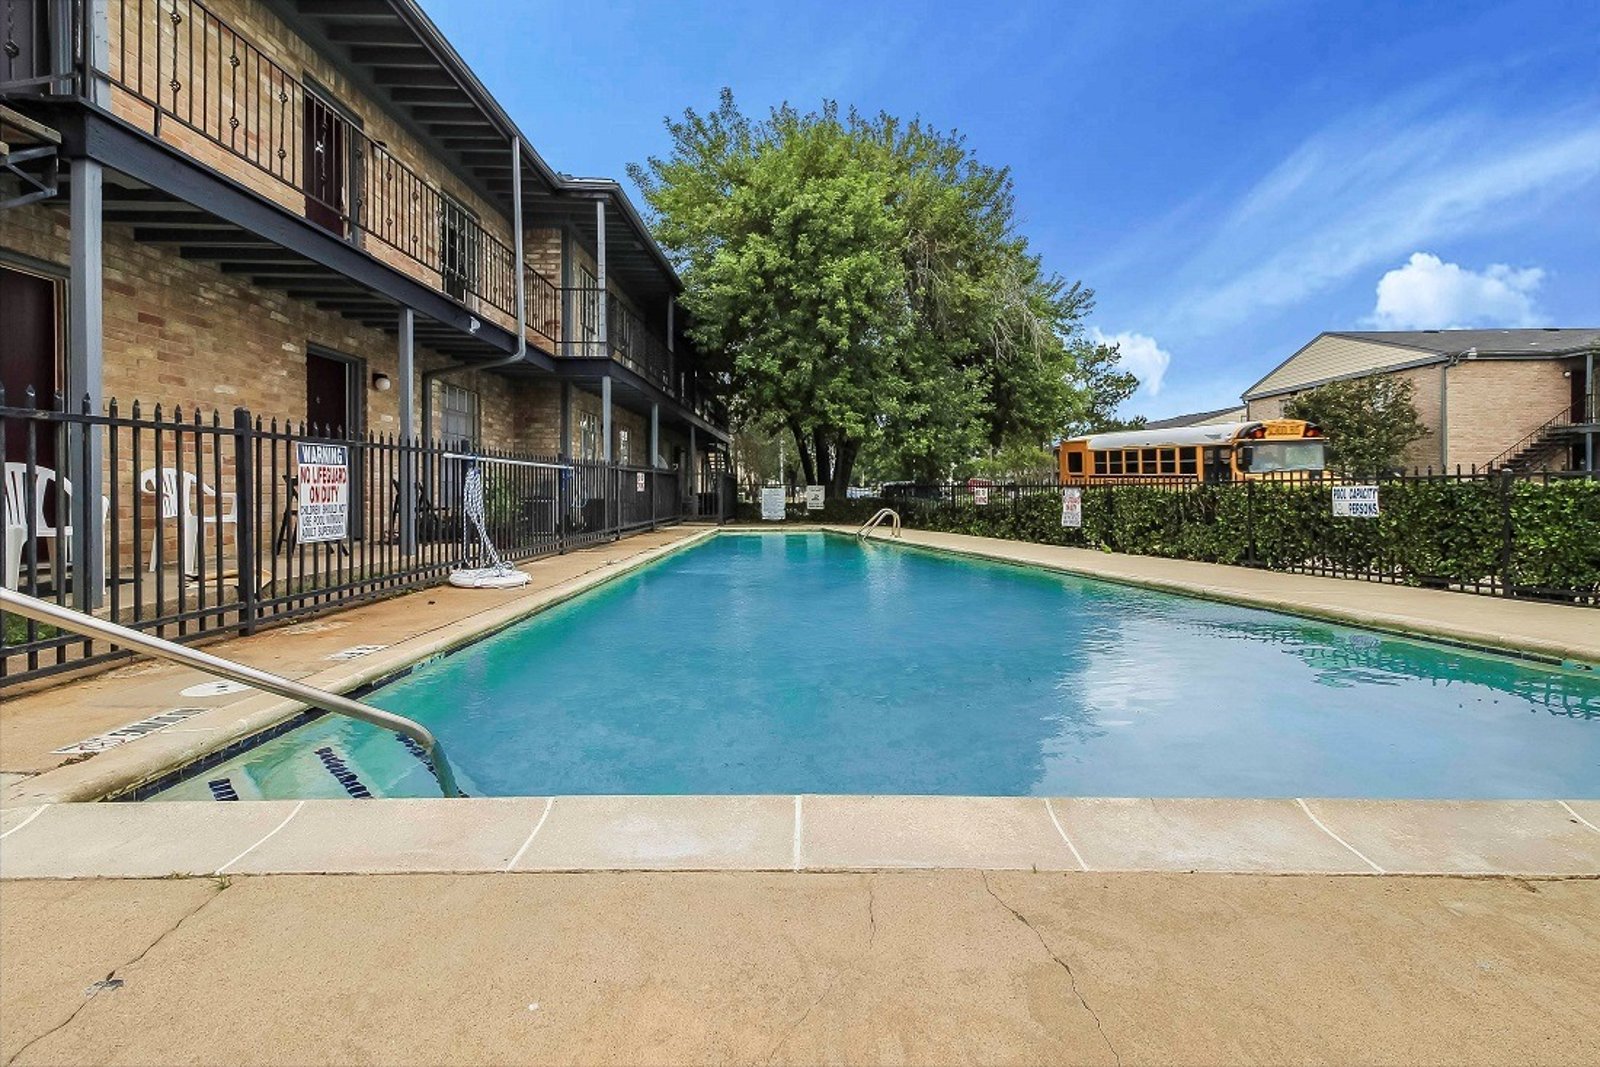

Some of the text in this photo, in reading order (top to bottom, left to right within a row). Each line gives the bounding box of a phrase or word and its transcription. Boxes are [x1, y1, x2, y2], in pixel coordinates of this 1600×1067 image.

[302, 445, 343, 465] WARNING
[300, 466, 347, 484] NO LIFEGUARD
[310, 485, 340, 504] ON DUTY
[1333, 487, 1377, 499] POOL CAPACITY
[300, 505, 321, 515] CHILDREN
[322, 504, 338, 514] SHOULD
[1349, 502, 1377, 515] PERSONS
[313, 515, 325, 526] POOL
[302, 525, 344, 539] ADULT SUPERVISION
